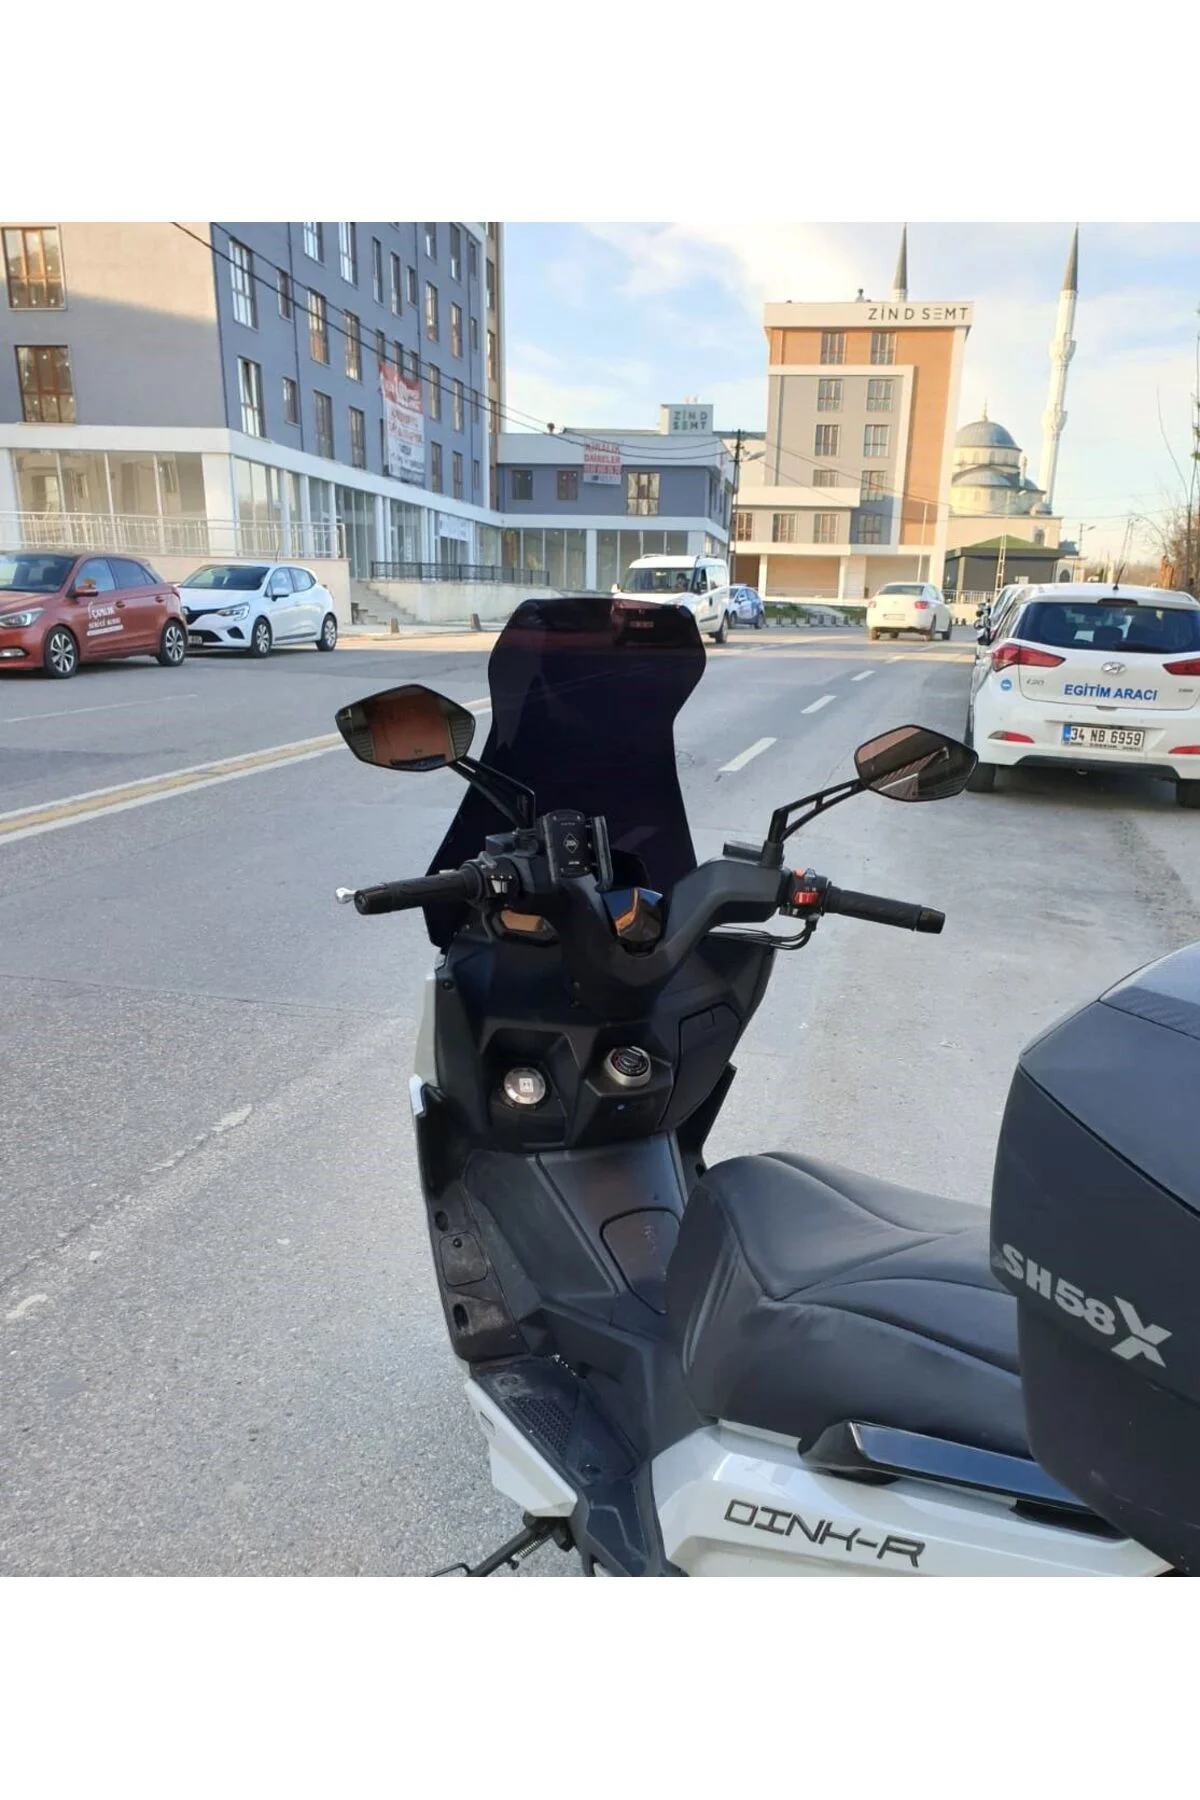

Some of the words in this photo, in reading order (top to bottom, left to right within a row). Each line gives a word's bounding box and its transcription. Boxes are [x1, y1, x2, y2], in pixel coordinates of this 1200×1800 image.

[868, 304, 915, 320] ZİND
[922, 307, 969, 320] SEMT
[1113, 687, 1158, 701] ARACI
[1071, 726, 1086, 741] 34
[1090, 728, 1106, 743] NB
[1110, 730, 1142, 746] 6959
